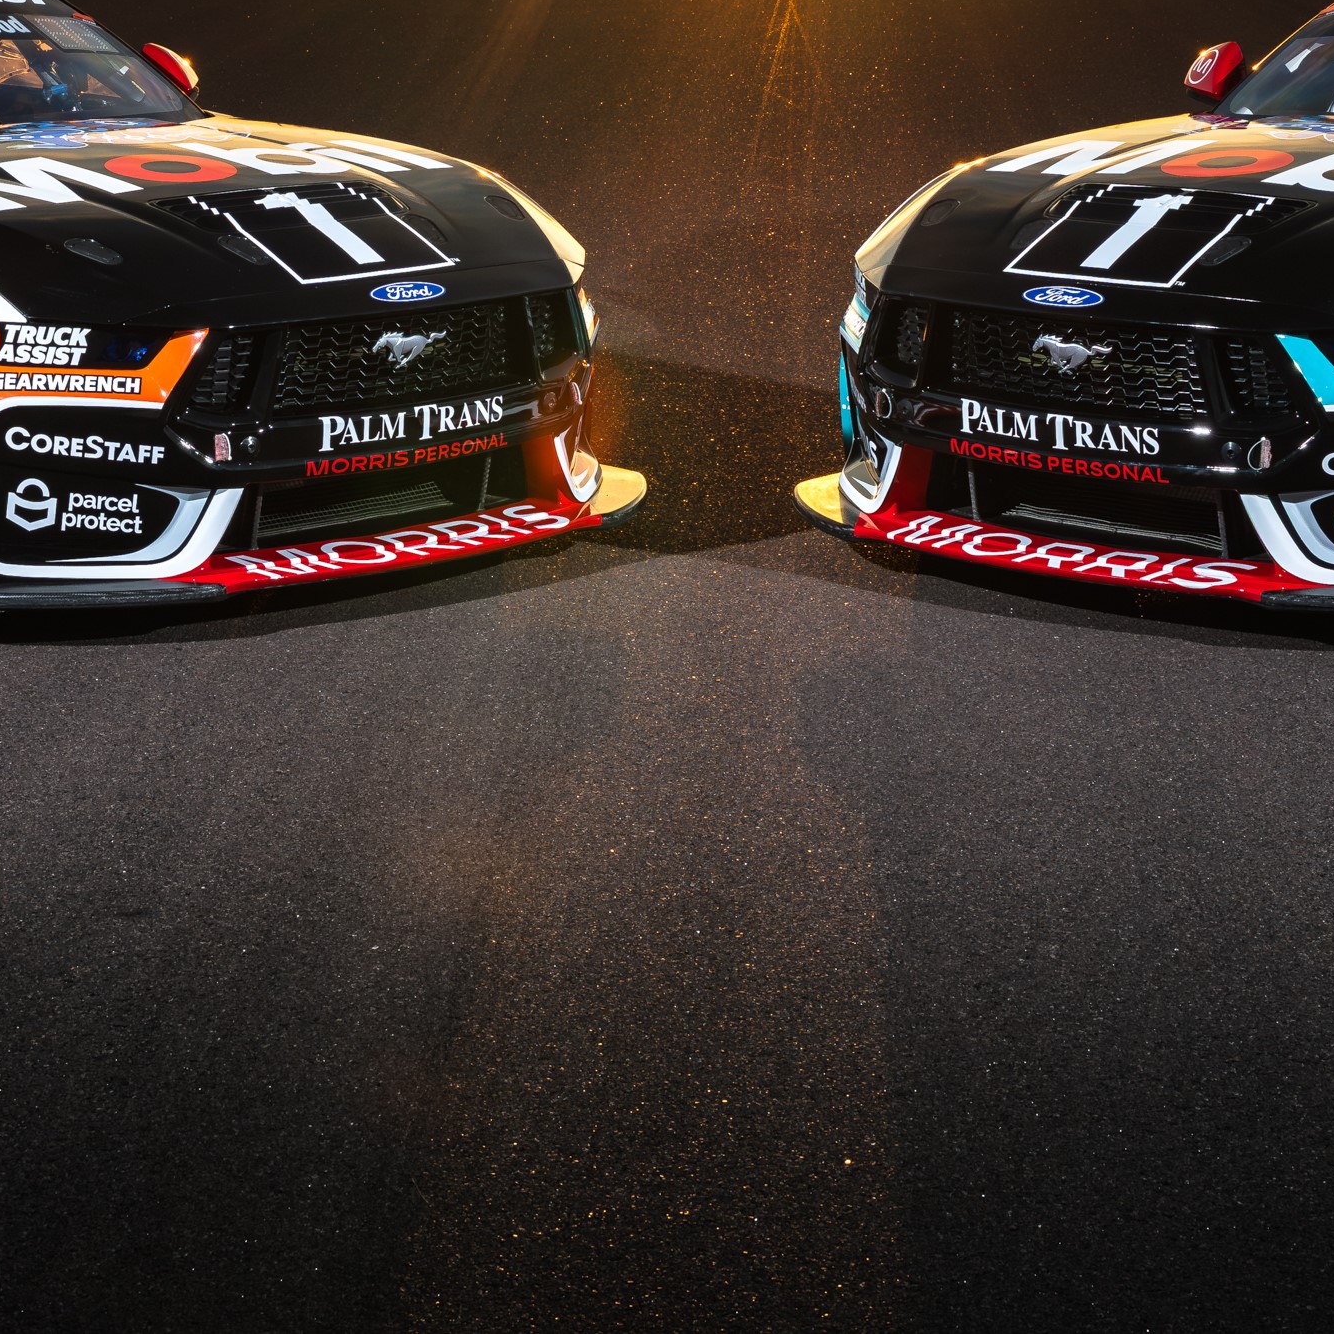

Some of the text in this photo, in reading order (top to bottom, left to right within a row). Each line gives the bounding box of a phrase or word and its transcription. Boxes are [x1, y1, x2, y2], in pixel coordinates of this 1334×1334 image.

[1194, 57, 1212, 74] M
[254, 192, 385, 265] 1
[1080, 194, 1193, 269] 1
[385, 284, 435, 301] Ford
[1041, 287, 1086, 306] Ford
[4, 324, 91, 347] TRUCK
[306, 432, 508, 477] MORRIS PERSONAL
[950, 438, 1170, 485] MORRIS PERSONAL
[68, 491, 139, 514] parcel
[61, 510, 143, 534] protect
[225, 504, 570, 580] MORRIS
[886, 515, 1258, 588] MORRIS
